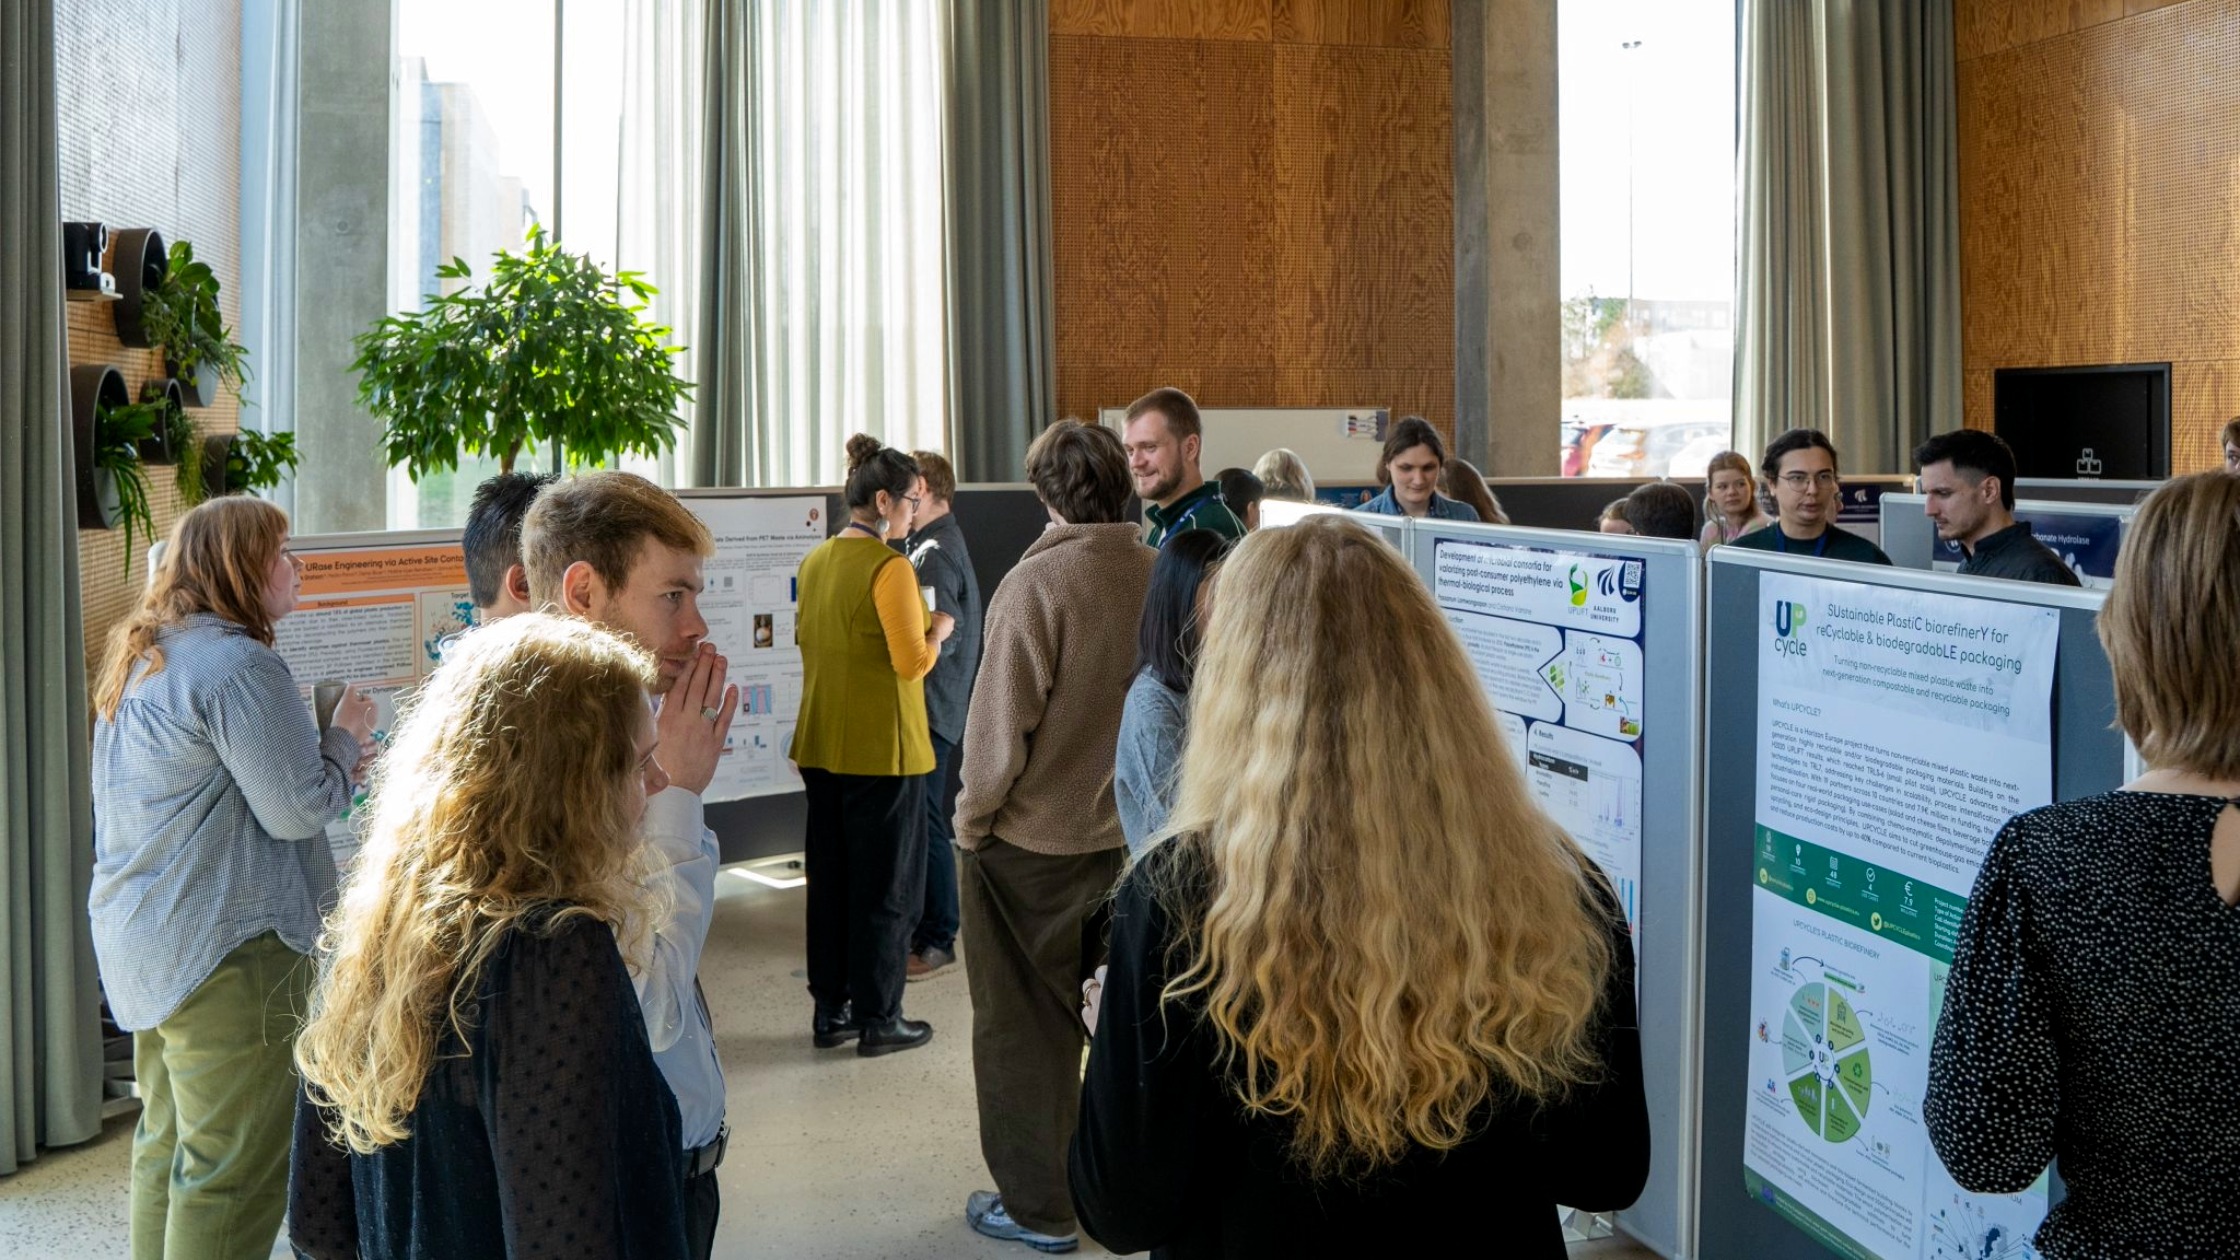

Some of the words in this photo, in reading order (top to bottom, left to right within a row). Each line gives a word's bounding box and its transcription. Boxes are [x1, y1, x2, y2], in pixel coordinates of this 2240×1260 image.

[2032, 532, 2058, 542] rbonate
[2058, 533, 2090, 545] Hydrolase
[306, 562, 333, 572] URase
[335, 560, 383, 572] Engineering
[385, 558, 397, 567] via
[398, 557, 423, 566] Active
[425, 555, 438, 564] Site
[440, 554, 465, 563] Conta
[1440, 549, 1476, 564] Development
[1478, 555, 1484, 563] of
[1514, 559, 1542, 571] consortia
[1543, 561, 1552, 572] for
[1438, 577, 1490, 594] thermal-biological
[1492, 585, 1514, 597] process
[1440, 564, 1465, 577] valorizing
[1467, 568, 1509, 582] post-consumer
[1510, 573, 1551, 588] polyethylene
[1553, 578, 1563, 589] via
[451, 592, 469, 600] Target
[1568, 606, 1588, 616] UPLIFT
[1590, 614, 1619, 623] UNIVERSITY
[1594, 606, 1616, 614] AALBORG
[1776, 600, 1807, 639] UP
[1828, 604, 1884, 625] SUstainable
[1887, 612, 1923, 631] PlastiC
[1926, 619, 1989, 642] biorefinerY
[1992, 628, 2009, 644] for
[1775, 638, 1807, 659] cycle
[1816, 624, 1865, 644] reCyclable
[1866, 631, 1873, 645] &
[1876, 634, 1957, 660] biodegradabLE
[1960, 650, 2022, 675] packaging
[1834, 655, 1858, 670] Turning
[1859, 662, 1907, 679] non-recyclable
[1908, 669, 1929, 682] mixed
[1930, 674, 1955, 688] plastic
[1956, 680, 1977, 692] waste
[1978, 684, 1994, 695] into
[1823, 668, 1871, 685] next-generation
[1872, 678, 1915, 695] compostable
[1916, 688, 1930, 698] and
[1931, 692, 1968, 707] recyclable
[1970, 698, 2010, 717] packaging
[1773, 698, 1790, 709] What's
[1791, 702, 1821, 717] UPCYCLE?
[1772, 720, 1793, 732] UPCYCLE
[1804, 728, 1824, 739] Horizon
[1825, 732, 1843, 745] Europe
[1844, 740, 1863, 750] project
[1864, 743, 1875, 753] that
[1876, 746, 1890, 757] turns
[1891, 751, 1930, 768] non-recyclable
[1932, 762, 1949, 772] mixed
[1950, 766, 1969, 779] plastic
[1971, 773, 1988, 784] waste
[1989, 775, 2001, 787] into
[2003, 781, 2020, 792] next-
[1825, 766, 1854, 782] addressing
[1854, 775, 1864, 785] key
[1935, 800, 1957, 812] process
[1960, 806, 2001, 824] intensification
[1906, 768, 1935, 783] packaging
[1968, 782, 1994, 799] Building
[1997, 793, 2005, 801] on
[2008, 794, 2020, 805] the
[1830, 780, 1853, 792] partners
[1854, 787, 1871, 797] across
[1872, 791, 1878, 799] 10
[1905, 801, 1916, 811] and
[1930, 811, 1949, 821] million
[1939, 787, 1967, 803] UPCYCLE
[1970, 797, 1999, 812] advances
[1796, 780, 1806, 789] four
[1834, 792, 1861, 807] packaging
[1862, 801, 1887, 814] use-cases
[1905, 813, 1916, 823] and
[1917, 818, 1937, 829] cheese
[1953, 828, 1981, 845] beverage
[1849, 806, 1856, 816] By
[1857, 810, 1886, 826] combining
[1796, 814, 1824, 828] production
[1825, 823, 1839, 832] costs
[1840, 828, 1846, 836] by
[1846, 831, 1854, 839] up
[1861, 834, 1871, 844] 40%
[1872, 838, 1900, 853] compared
[1907, 851, 1928, 863] current
[1928, 856, 1960, 874] bioplastics.
[1862, 822, 1888, 837] UPCYCLE
[1910, 839, 1919, 847] cut
[1920, 842, 1965, 864] greenhouse-gas
[1830, 870, 1838, 879] 48
[1868, 883, 1873, 891] 4
[1904, 881, 1913, 897] €
[1822, 930, 1843, 946] PLASTIC
[1844, 939, 1880, 960] BIOREFINERY
